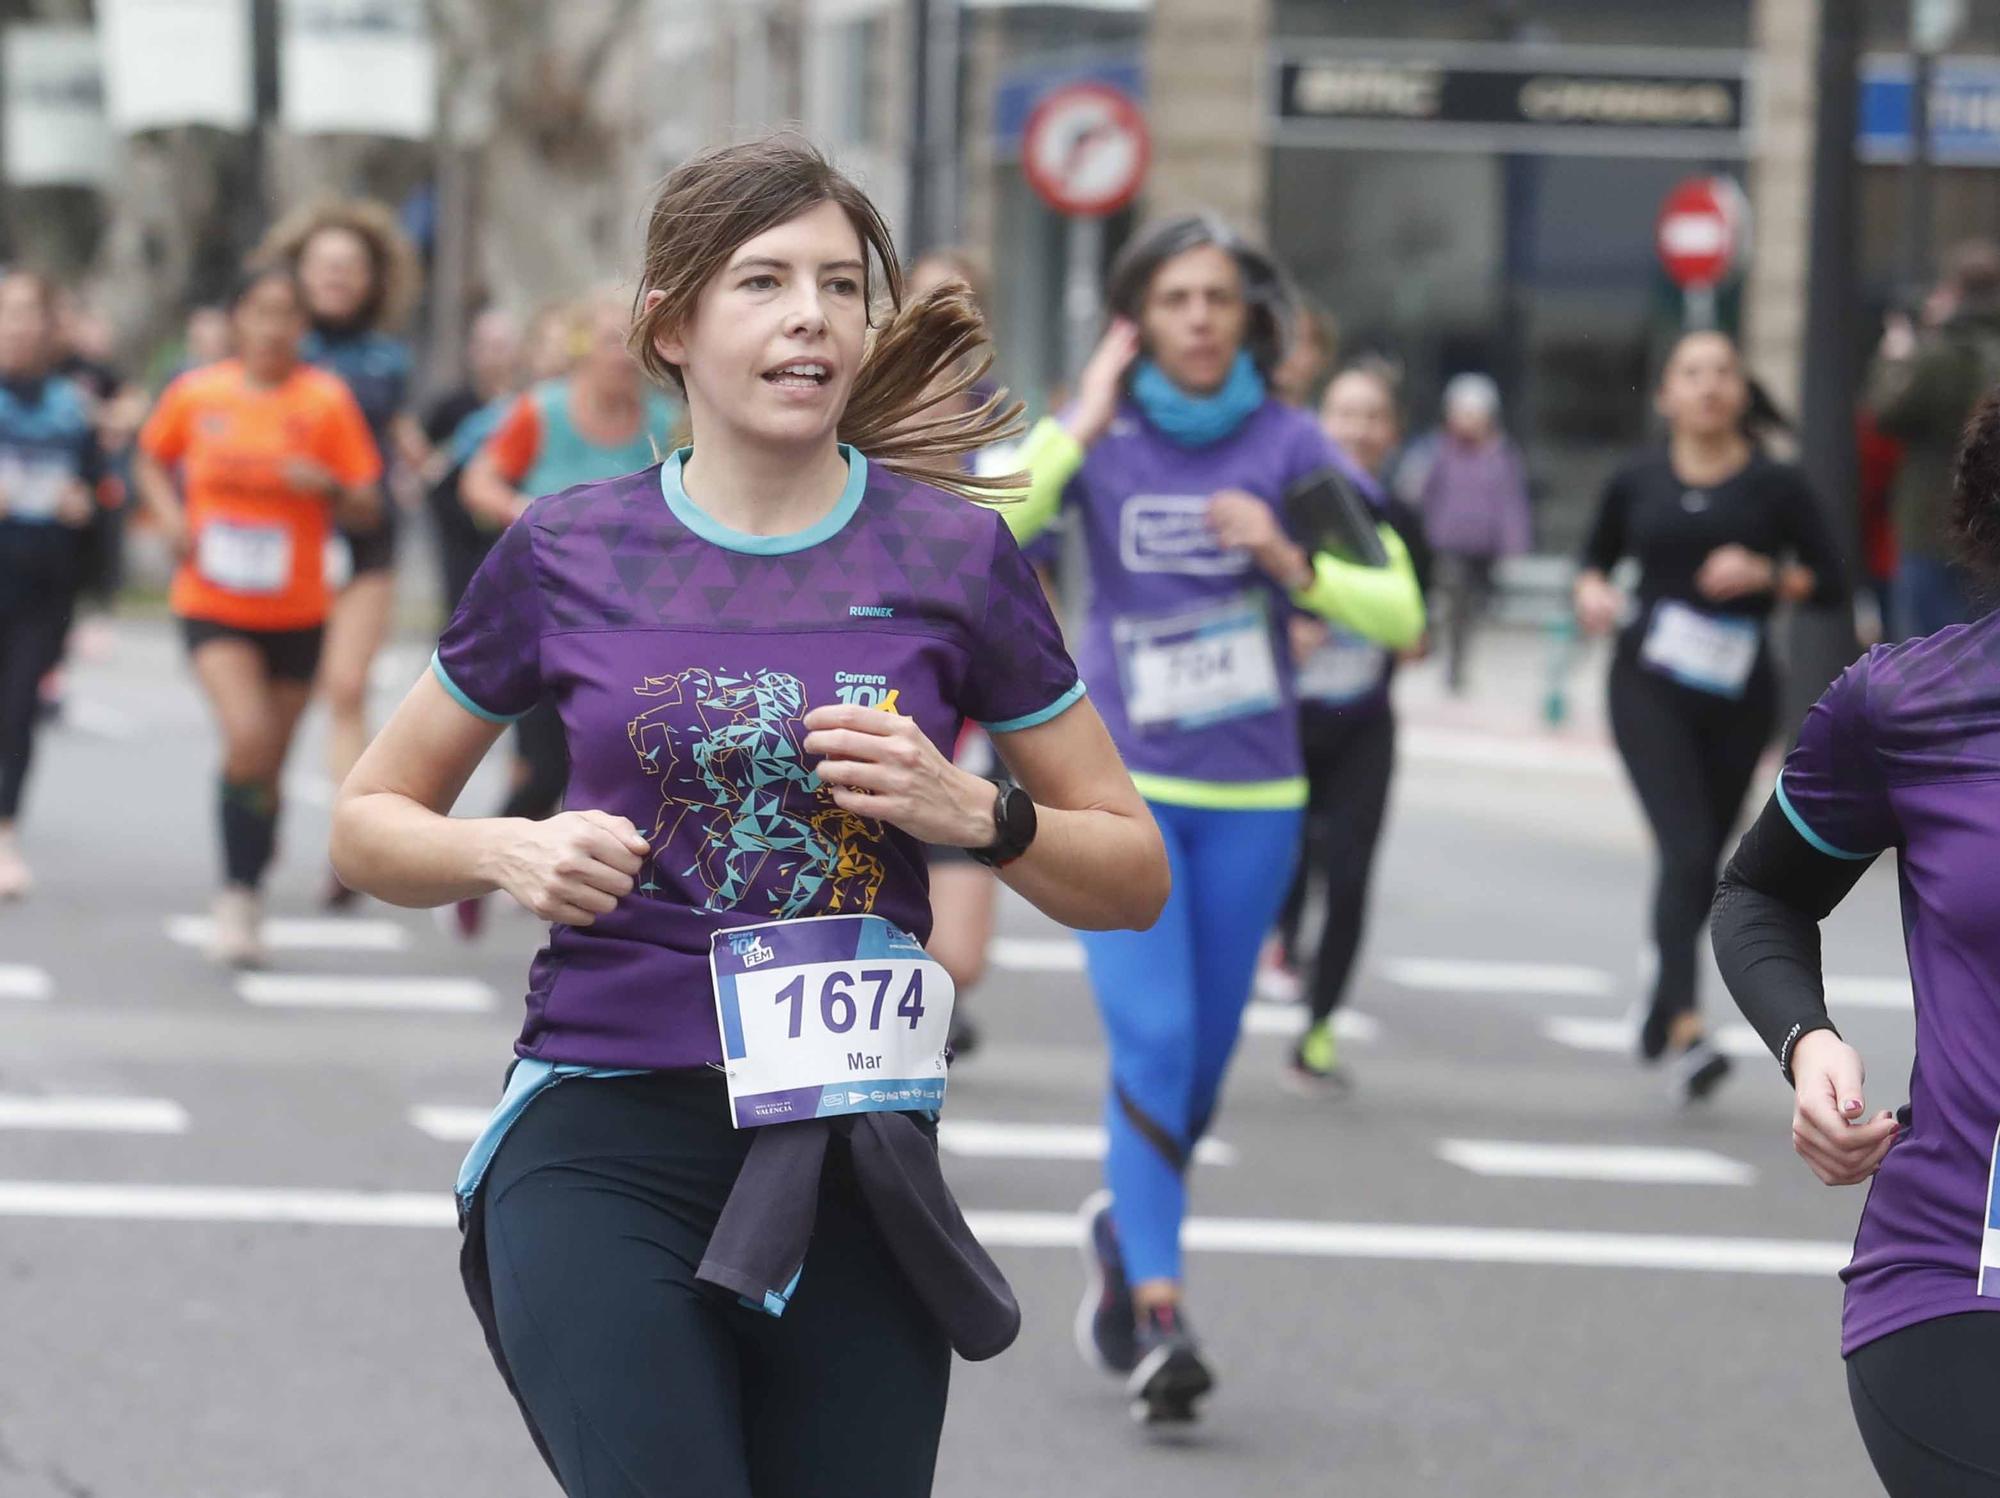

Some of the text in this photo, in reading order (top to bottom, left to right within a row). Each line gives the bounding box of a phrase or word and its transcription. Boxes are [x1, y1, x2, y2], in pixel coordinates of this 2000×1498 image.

[835, 671, 886, 685] Carrera
[746, 949, 771, 965] FEM
[775, 968, 925, 1039] 1674
[847, 1053, 882, 1070] Mar
